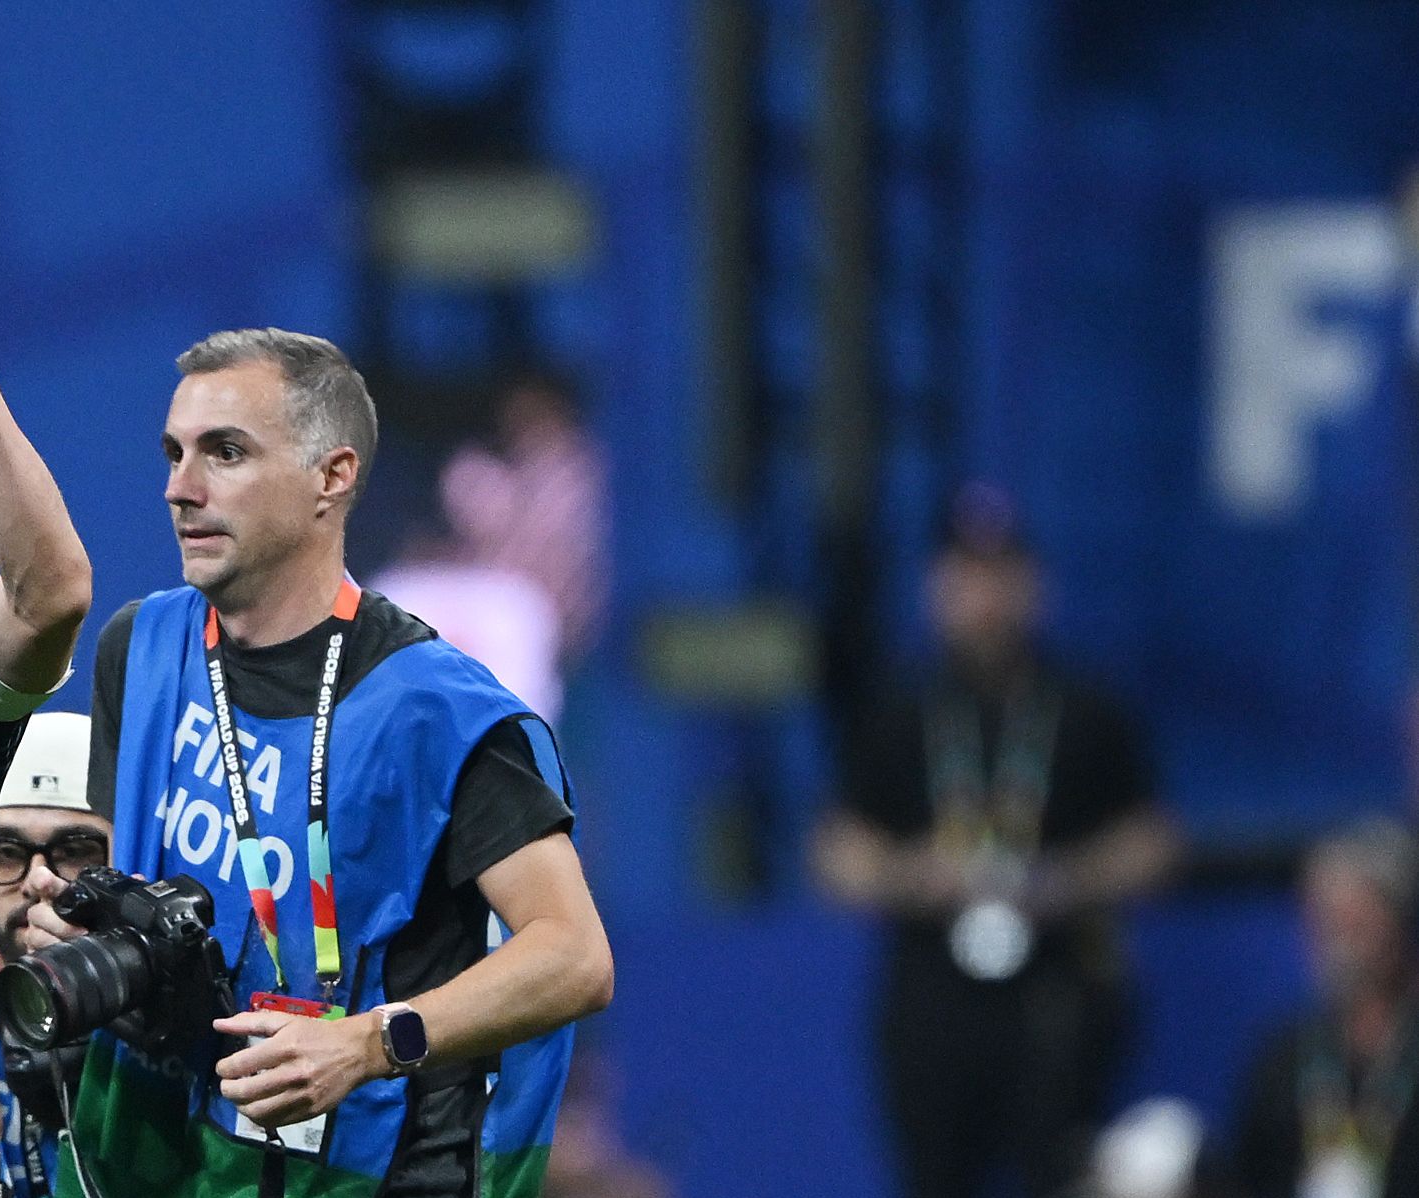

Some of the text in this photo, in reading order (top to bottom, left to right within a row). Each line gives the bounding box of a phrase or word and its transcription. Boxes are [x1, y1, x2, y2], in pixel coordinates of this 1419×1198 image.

[208, 659, 250, 826] FIFA WORLD CUP 2026
[311, 632, 344, 806] FIFA WORLD CUP 2026
[154, 787, 295, 902] HOTO
